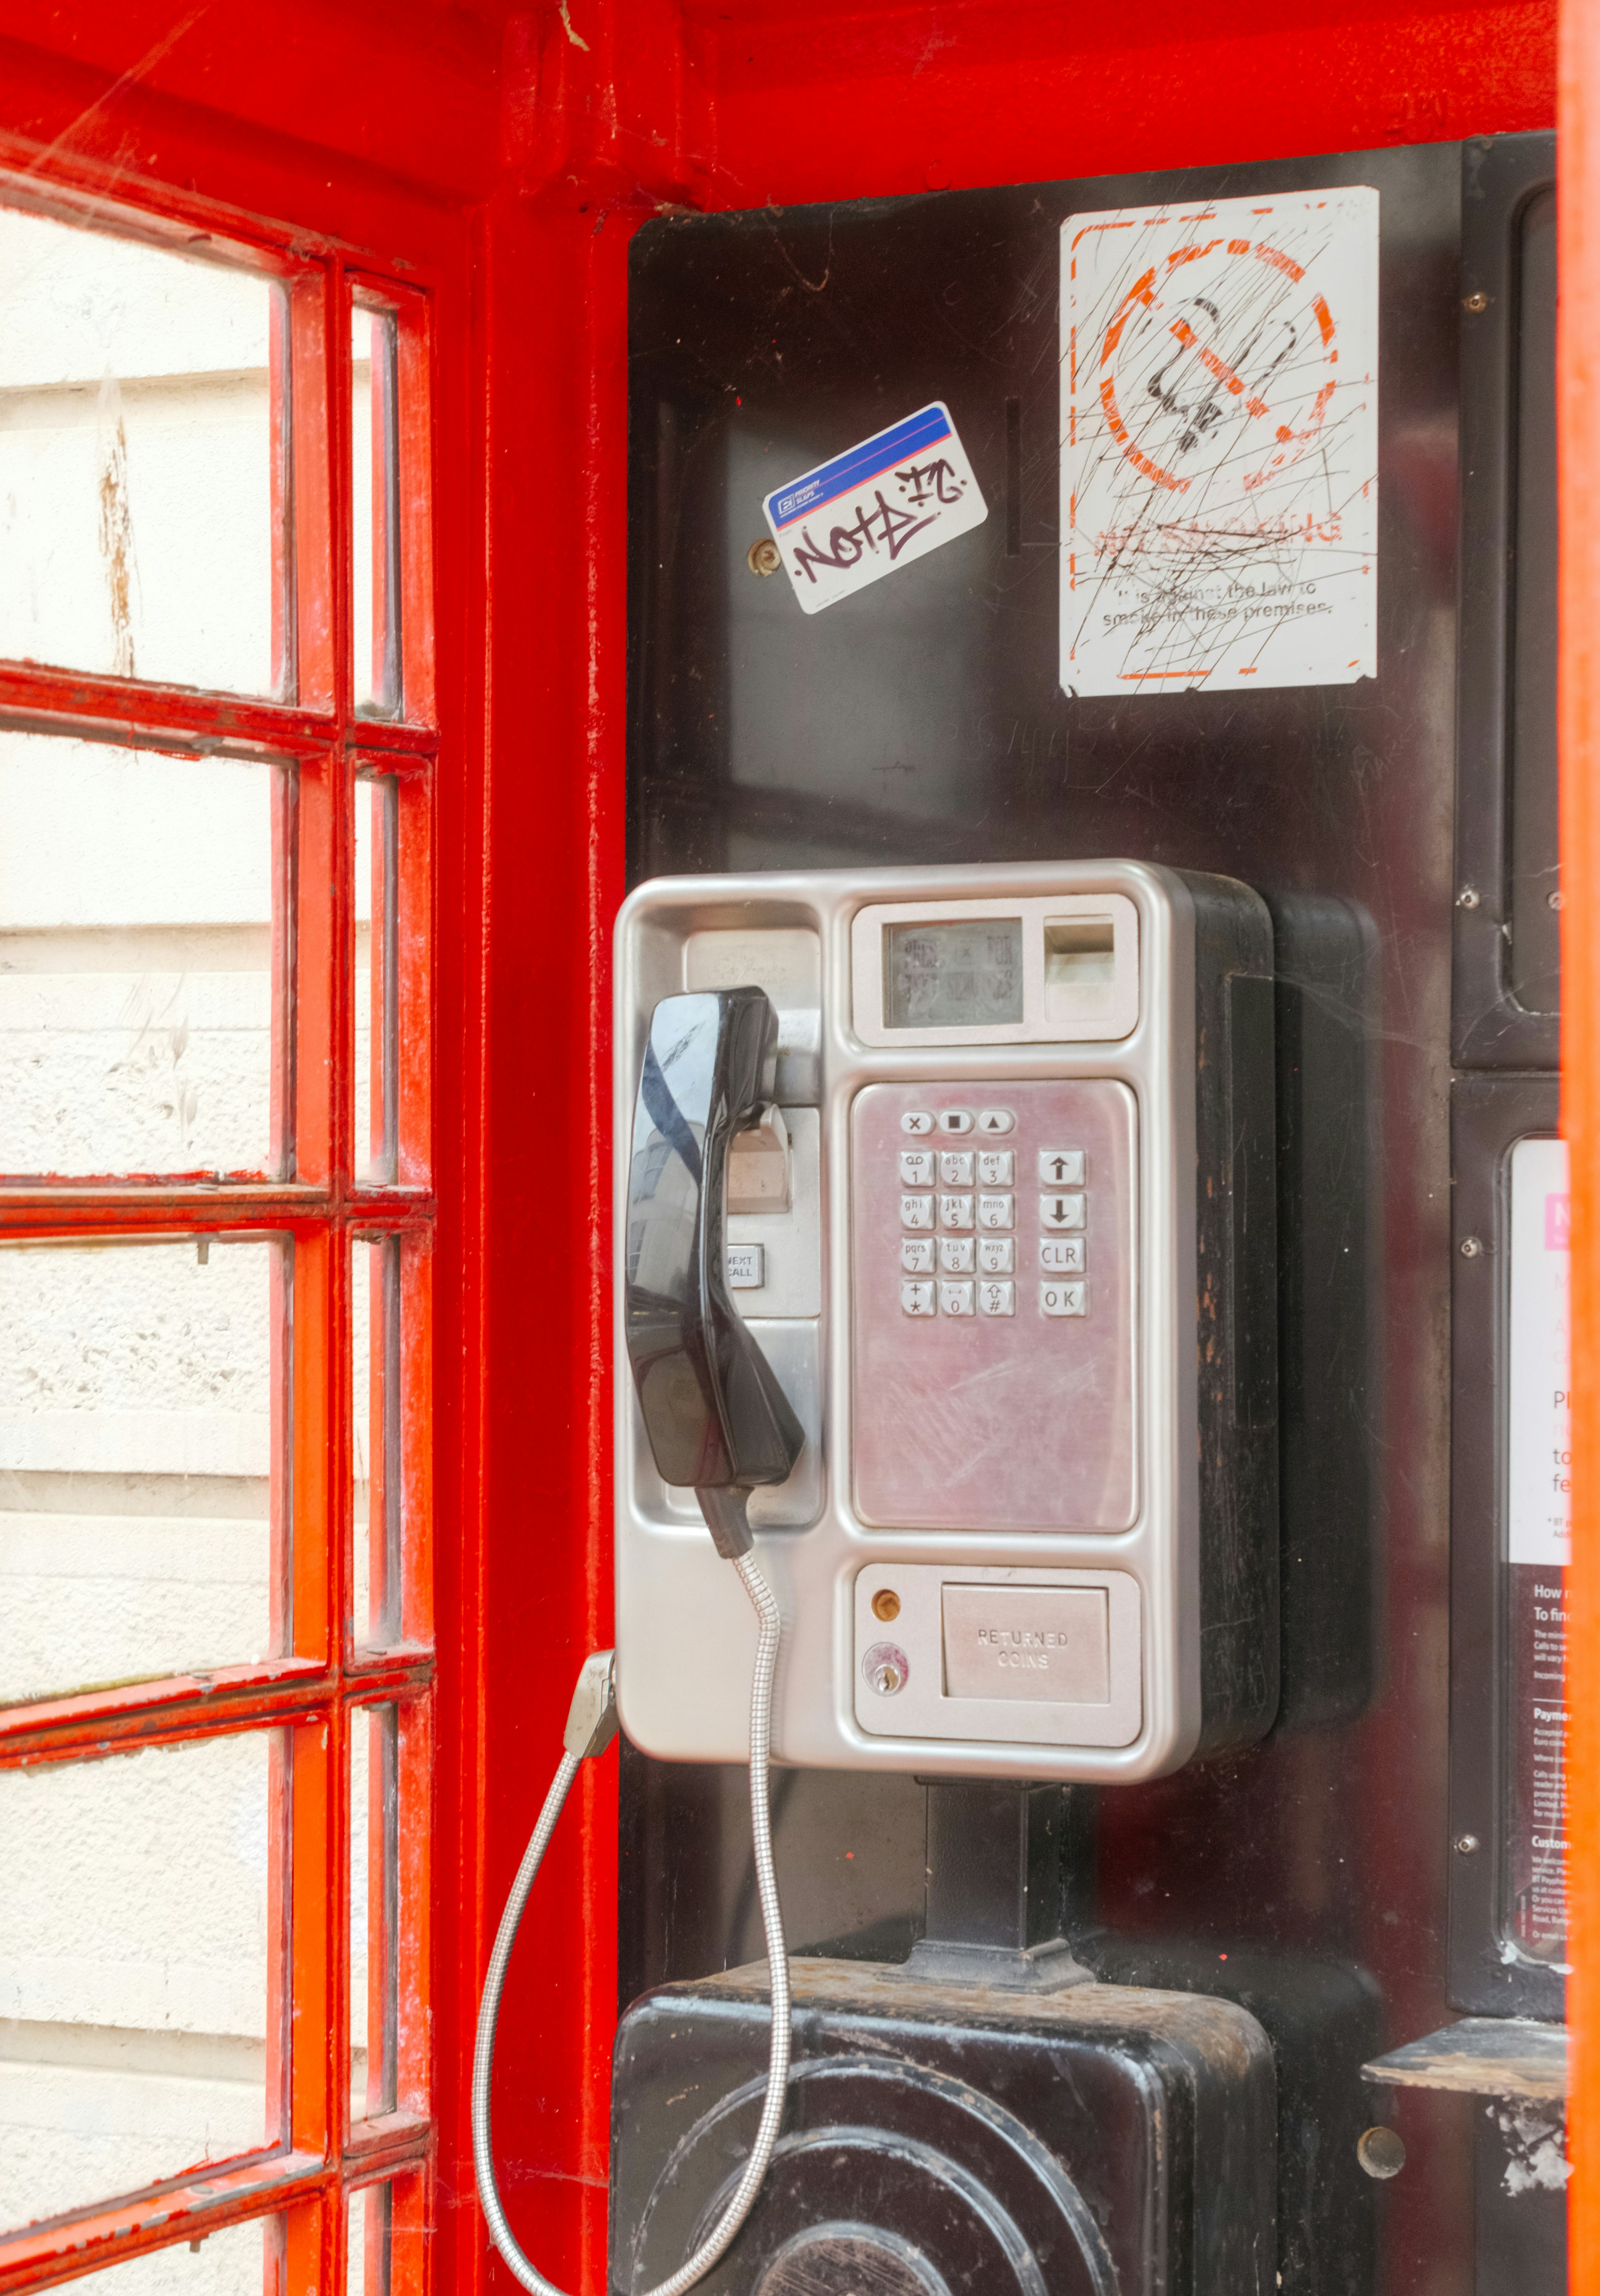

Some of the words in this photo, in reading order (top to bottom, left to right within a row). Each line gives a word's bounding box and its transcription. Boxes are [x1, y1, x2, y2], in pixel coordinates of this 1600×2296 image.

[945, 1157, 964, 1165] abc
[983, 1156, 1001, 1165] def
[913, 1171, 918, 1183] 1
[952, 1170, 958, 1182] 2
[990, 1170, 997, 1183] 3
[905, 1200, 923, 1211] ghi
[945, 1200, 963, 1211] jkl
[983, 1201, 1004, 1209] mno
[910, 1214, 919, 1226] 4
[951, 1214, 958, 1226] 5
[990, 1214, 997, 1226] 6
[905, 1245, 926, 1254] pqrs
[947, 1244, 965, 1252] tuv
[985, 1244, 1004, 1253] wxyz
[1042, 1248, 1076, 1263] CLR
[912, 1258, 919, 1270] 7
[952, 1257, 960, 1269] 8
[990, 1258, 997, 1269] 9
[1045, 1291, 1075, 1307] OK
[1534, 1584, 1562, 1599] How
[1534, 1606, 1548, 1621] To
[977, 1629, 1068, 1649] RETURNED
[998, 1650, 1050, 1669] COINS
[1532, 1835, 1571, 1849] Custom
